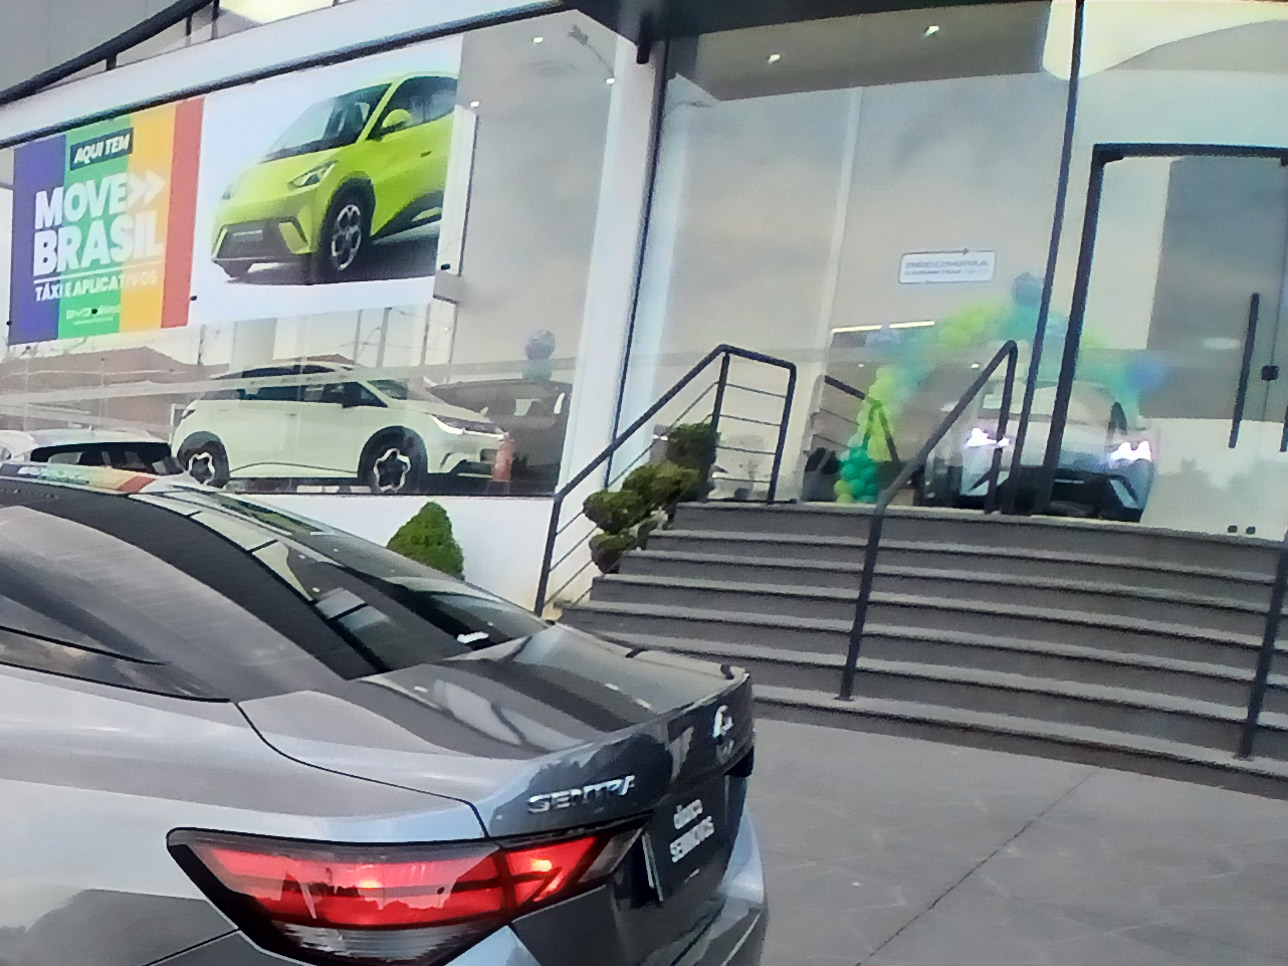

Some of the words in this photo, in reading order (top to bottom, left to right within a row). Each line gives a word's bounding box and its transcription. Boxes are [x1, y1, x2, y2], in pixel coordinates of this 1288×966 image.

[73, 140, 104, 164] AQUI
[105, 133, 130, 155] TEM
[35, 171, 129, 230] MOVE
[33, 209, 165, 277] BRASIL
[72, 268, 158, 297] APLICATIVOS
